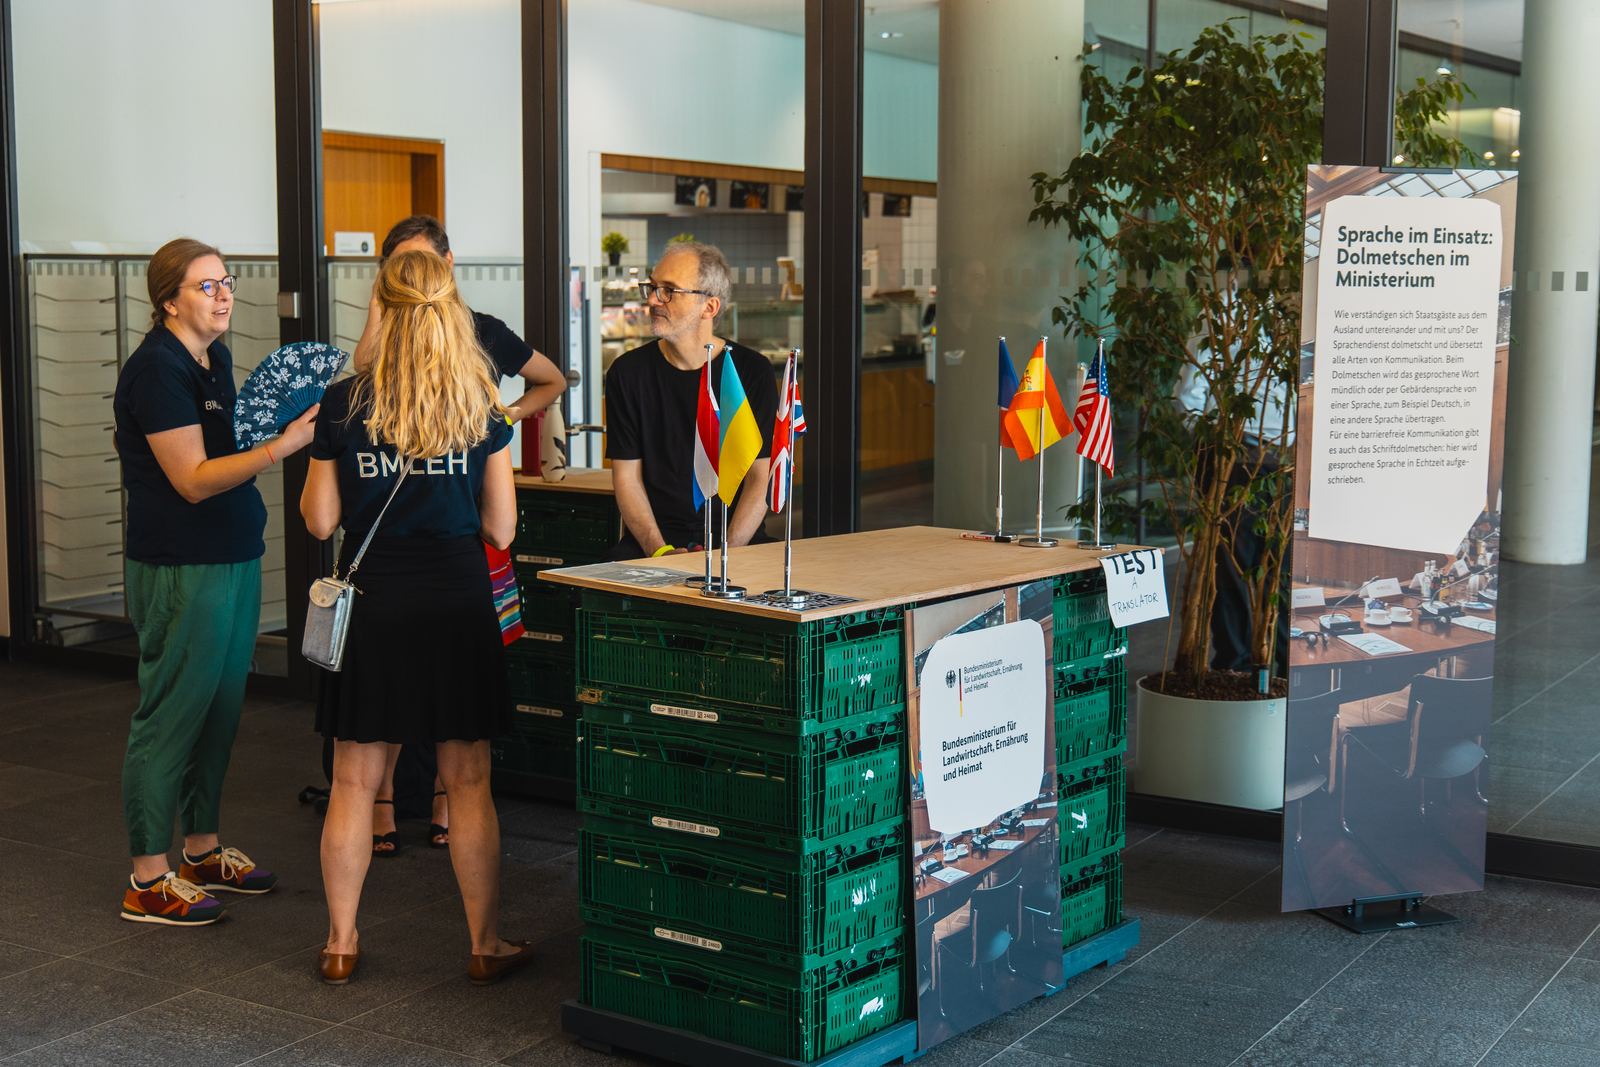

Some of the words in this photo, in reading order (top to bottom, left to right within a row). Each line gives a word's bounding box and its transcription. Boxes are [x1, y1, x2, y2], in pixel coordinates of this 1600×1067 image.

[1338, 225, 1404, 247] Sprache
[1409, 227, 1428, 243] im
[1434, 227, 1493, 244] Einsatz:
[1337, 248, 1445, 266] Dolmetschen
[1450, 250, 1469, 266] im
[1336, 270, 1435, 288] Ministerium
[1334, 310, 1349, 319] Wie
[1351, 310, 1398, 321] verständigen
[1399, 310, 1414, 319] sich
[1415, 310, 1456, 321] Staatsgäste
[1471, 311, 1487, 319] dem
[1333, 325, 1364, 335] Ausland
[1365, 325, 1417, 335] untereinander
[1418, 325, 1432, 334] und
[1434, 325, 1446, 334] mit
[1447, 325, 1465, 334] uns?
[1465, 325, 1479, 334] Der
[1333, 340, 1389, 351] Sprachendienst
[1391, 340, 1432, 350] dolmetscht
[1433, 340, 1448, 349] und
[1449, 340, 1483, 349] übersetzt
[1332, 355, 1346, 364] alle
[1346, 355, 1368, 364] Arten
[1385, 355, 1444, 364] Kommunikation.
[1446, 355, 1464, 364] Beim
[1332, 370, 1381, 381] Dolmetschen
[1382, 369, 1399, 379] wird
[1400, 369, 1413, 379] das
[1414, 370, 1460, 381] gesprochene
[1461, 369, 1479, 378] Wort
[1331, 385, 1366, 394] mündlich
[1367, 385, 1385, 394] oder
[1386, 387, 1399, 395] per
[1400, 385, 1463, 395] Gebärdensprache
[1330, 400, 1350, 409] einer
[1350, 400, 1382, 411] Sprache,
[1401, 399, 1429, 410] Beispiel
[1431, 399, 1462, 408] Deutsch,
[1463, 399, 1470, 407] in
[1330, 415, 1346, 424] eine
[1346, 415, 1373, 424] andere
[1374, 415, 1404, 425] Sprache
[1405, 415, 1446, 425] übertragen.
[1329, 430, 1342, 439] Für
[1343, 430, 1360, 439] eine
[1361, 429, 1405, 440] barrierefreie
[1406, 428, 1464, 438] Kommunikation
[1464, 428, 1479, 439] gibt
[1328, 447, 1337, 455] es
[1338, 445, 1357, 454] auch
[1358, 445, 1371, 454] das
[1372, 443, 1445, 455] Schriftdolmetschen:
[1446, 443, 1460, 452] hier
[1461, 442, 1477, 451] wird
[1328, 460, 1375, 471] gesprochene
[1376, 459, 1406, 469] Sprache
[1407, 458, 1415, 468] in
[1416, 458, 1445, 467] Echtzeit
[1446, 458, 1469, 468] aufge-
[1328, 473, 1365, 485] schrieben.
[1103, 549, 1157, 575] TEST
[1131, 576, 1138, 590] A
[1112, 593, 1159, 615] TRANSLATOR
[942, 725, 1006, 751] Bundesministerium
[1007, 720, 1017, 732] für
[942, 742, 995, 767] Landwirtschaft,
[995, 732, 1029, 749] Ernährung
[943, 767, 957, 782] und
[958, 761, 983, 777] Heimat
